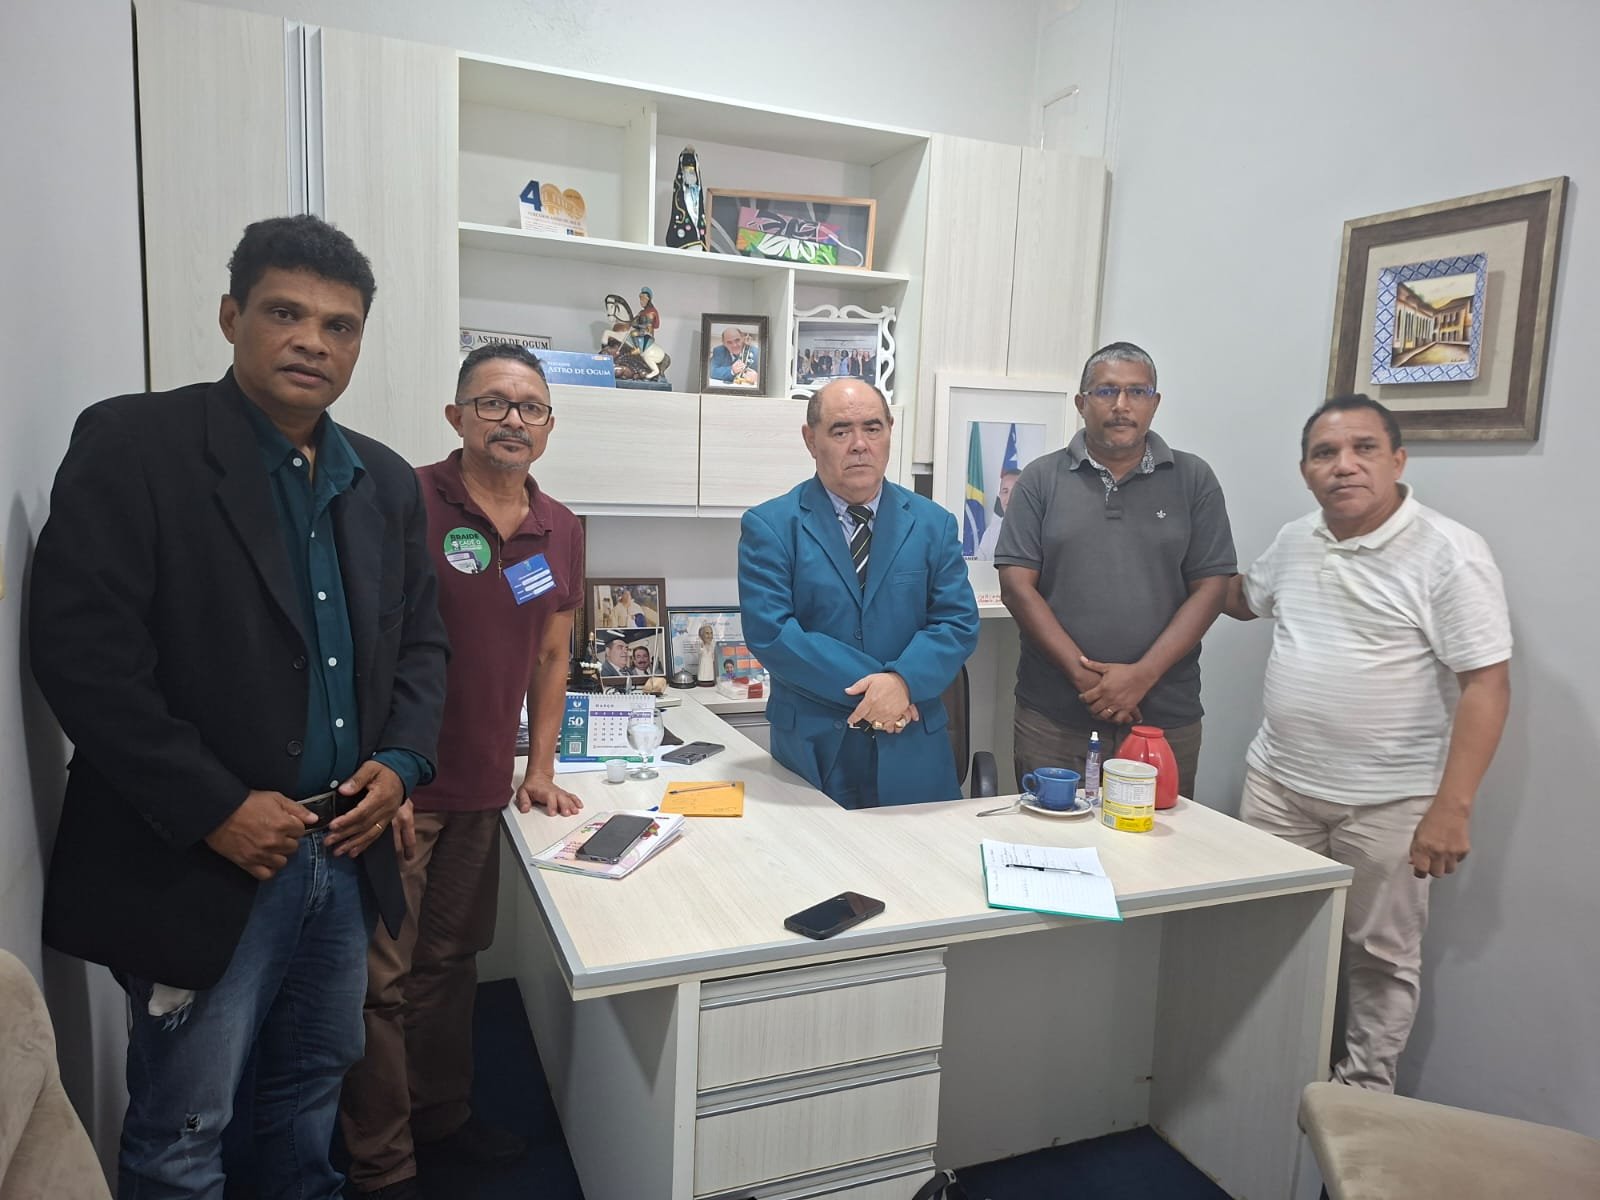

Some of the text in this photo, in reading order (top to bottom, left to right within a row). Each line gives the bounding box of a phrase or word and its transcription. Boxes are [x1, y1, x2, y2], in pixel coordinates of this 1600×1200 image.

[477, 335, 507, 345] ASTRO
[522, 339, 549, 350] OGUM
[548, 366, 573, 375] ASTRO
[586, 367, 611, 377] OGUM
[450, 533, 480, 541] BRAIDE
[567, 715, 585, 727] 50
